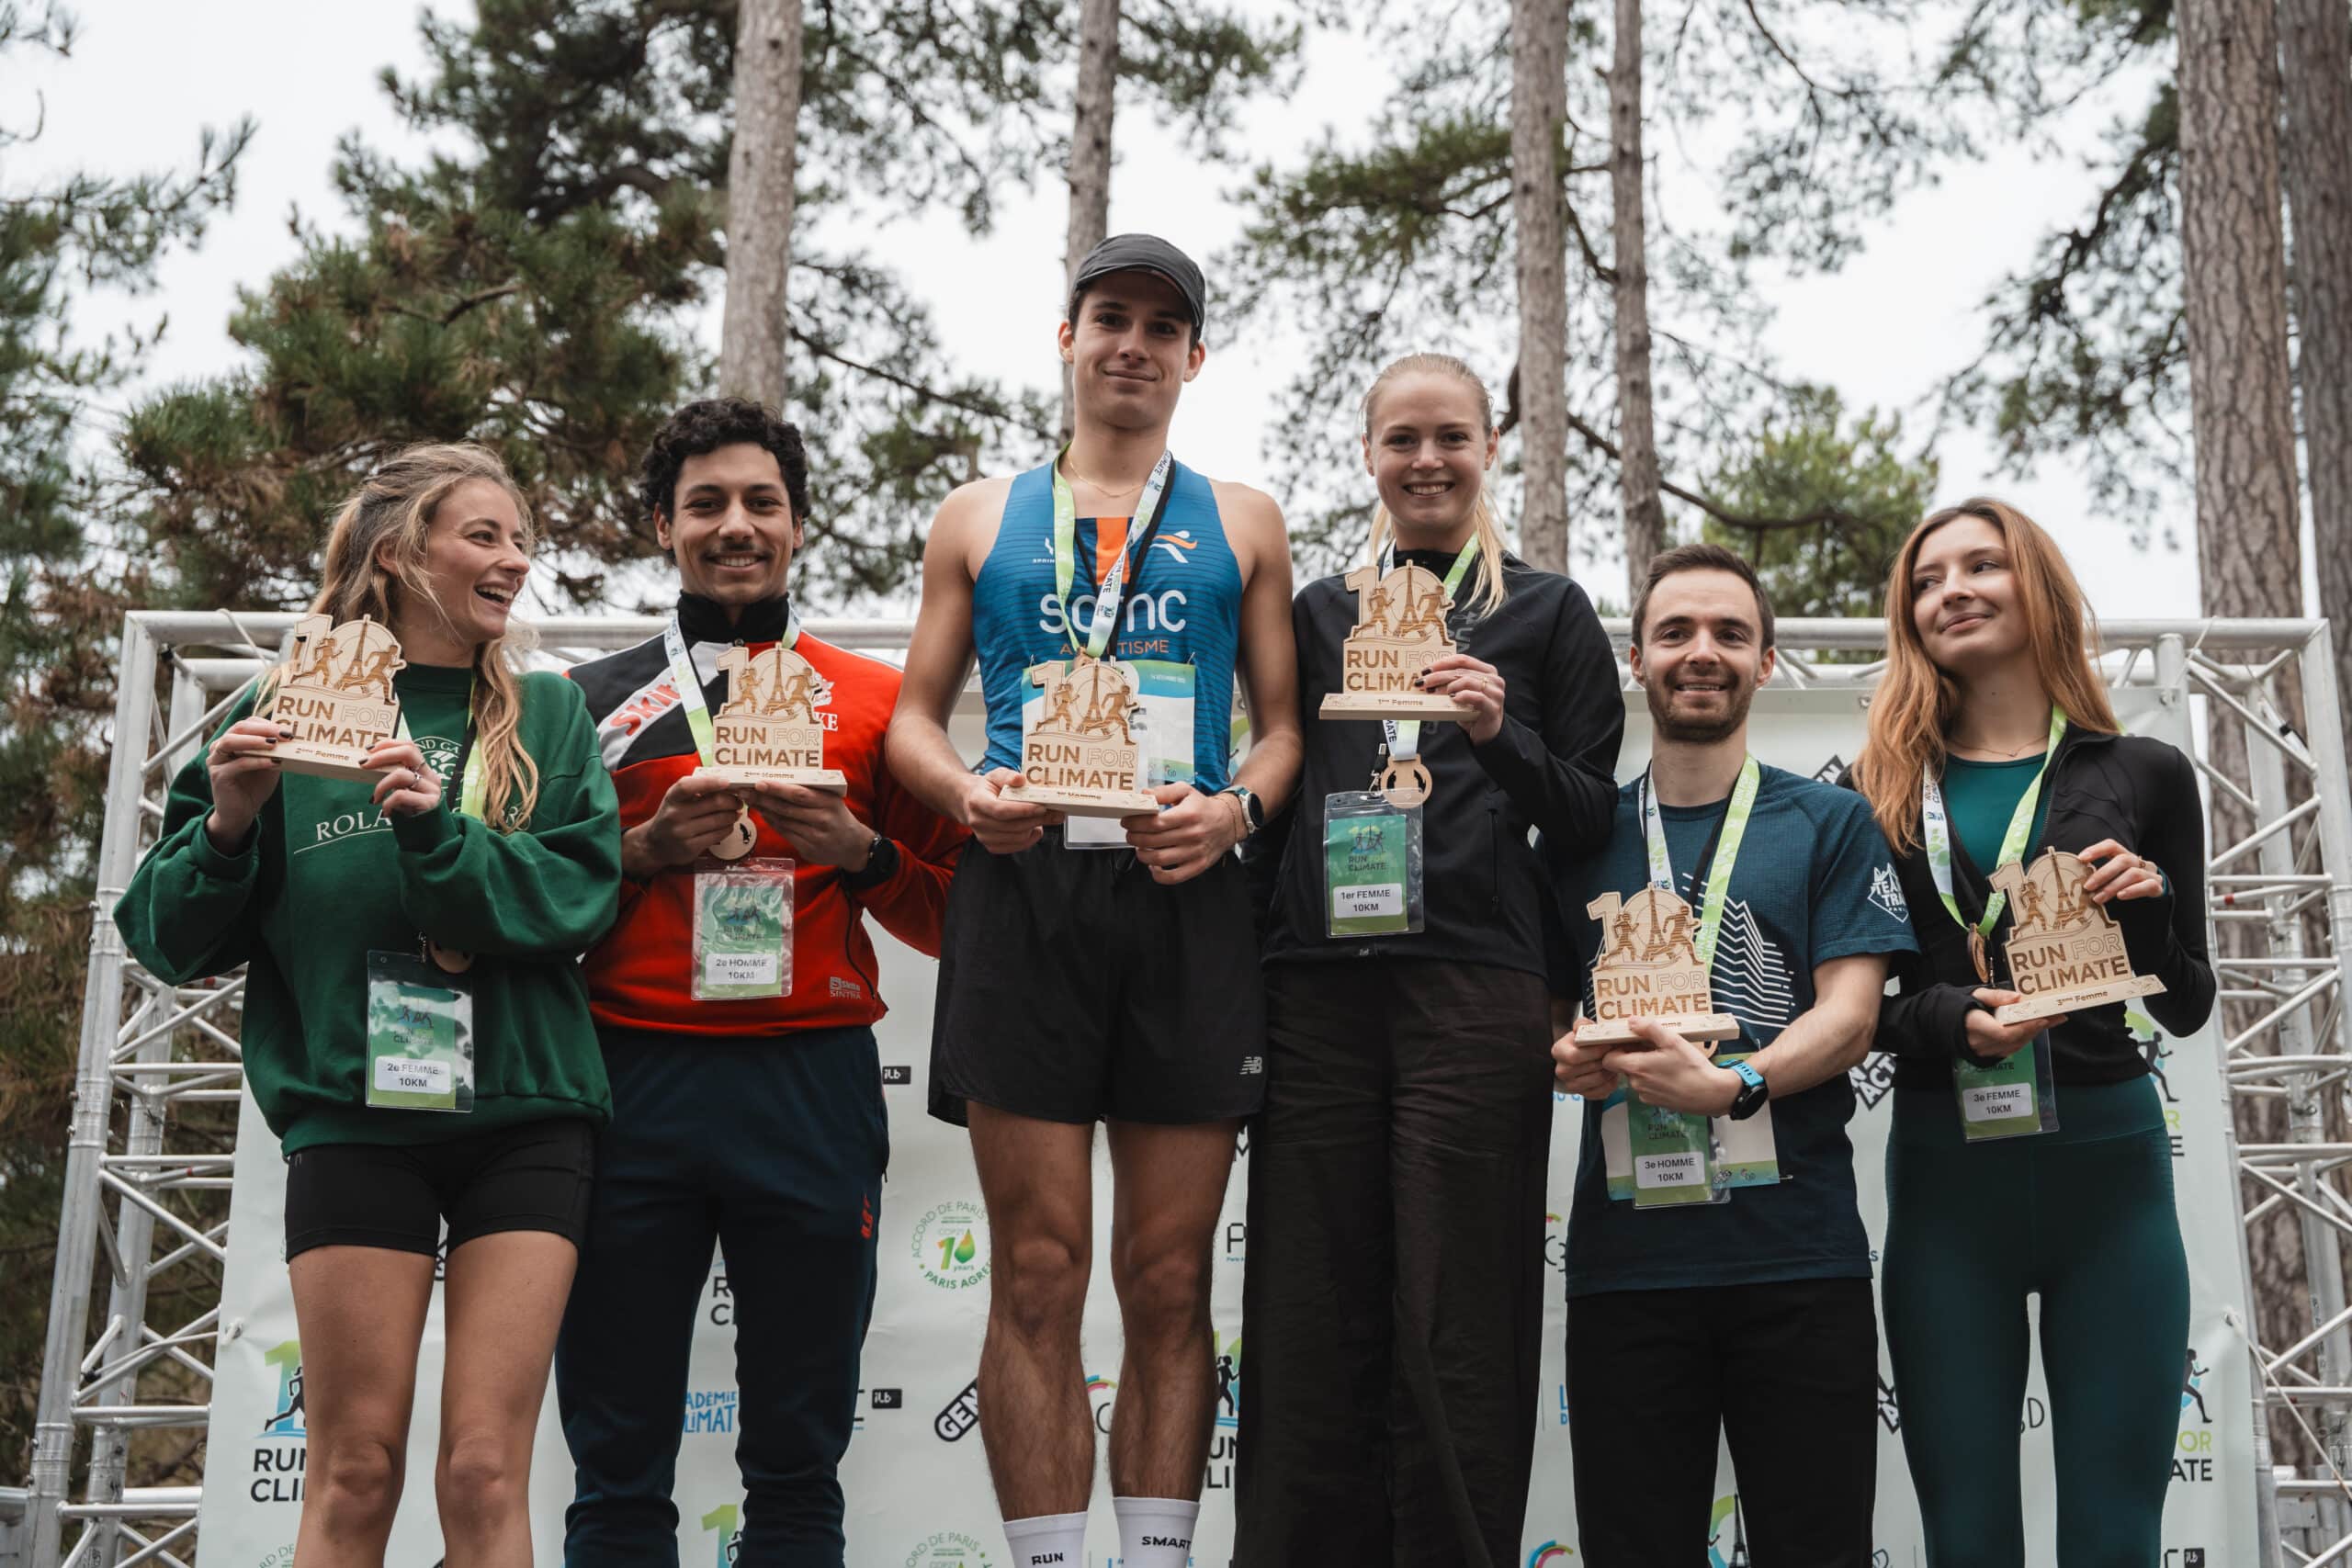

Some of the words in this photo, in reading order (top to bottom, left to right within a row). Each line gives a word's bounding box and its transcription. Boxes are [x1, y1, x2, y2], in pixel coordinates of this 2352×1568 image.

[1347, 650, 1398, 668] RUN
[277, 695, 335, 721] RUN
[340, 704, 392, 729] FOR
[716, 727, 766, 746] RUN
[773, 728, 820, 746] FOR
[715, 748, 820, 768] CLIMATE
[1027, 743, 1080, 764] RUN
[1086, 747, 1136, 768] FOR
[1025, 766, 1135, 790] CLIMATE
[315, 808, 392, 841] ROLA
[1340, 890, 1355, 899] 1er
[1357, 889, 1391, 898] FEMME
[1352, 903, 1379, 912] 10KM
[2011, 943, 2066, 973] RUN
[2071, 933, 2122, 960] FOR
[729, 958, 768, 967] HOMME
[1596, 975, 1651, 998] RUN
[1657, 970, 1706, 992] FOR
[2017, 956, 2129, 995] CLIMATE
[2075, 991, 2109, 1002] Femme
[1599, 992, 1709, 1021] CLIMATE
[399, 1077, 428, 1089] 10KM
[1986, 1089, 2021, 1100] FEMME
[1986, 1104, 2012, 1114] 10KM
[1645, 1161, 1657, 1169] 3e
[1657, 1157, 1695, 1168] HOMME
[1657, 1173, 1684, 1182] 10KM
[924, 1270, 957, 1290] PARIS
[2177, 1429, 2212, 1452] OR
[1141, 1535, 1192, 1551] SMART
[1031, 1551, 1065, 1566] RUN
